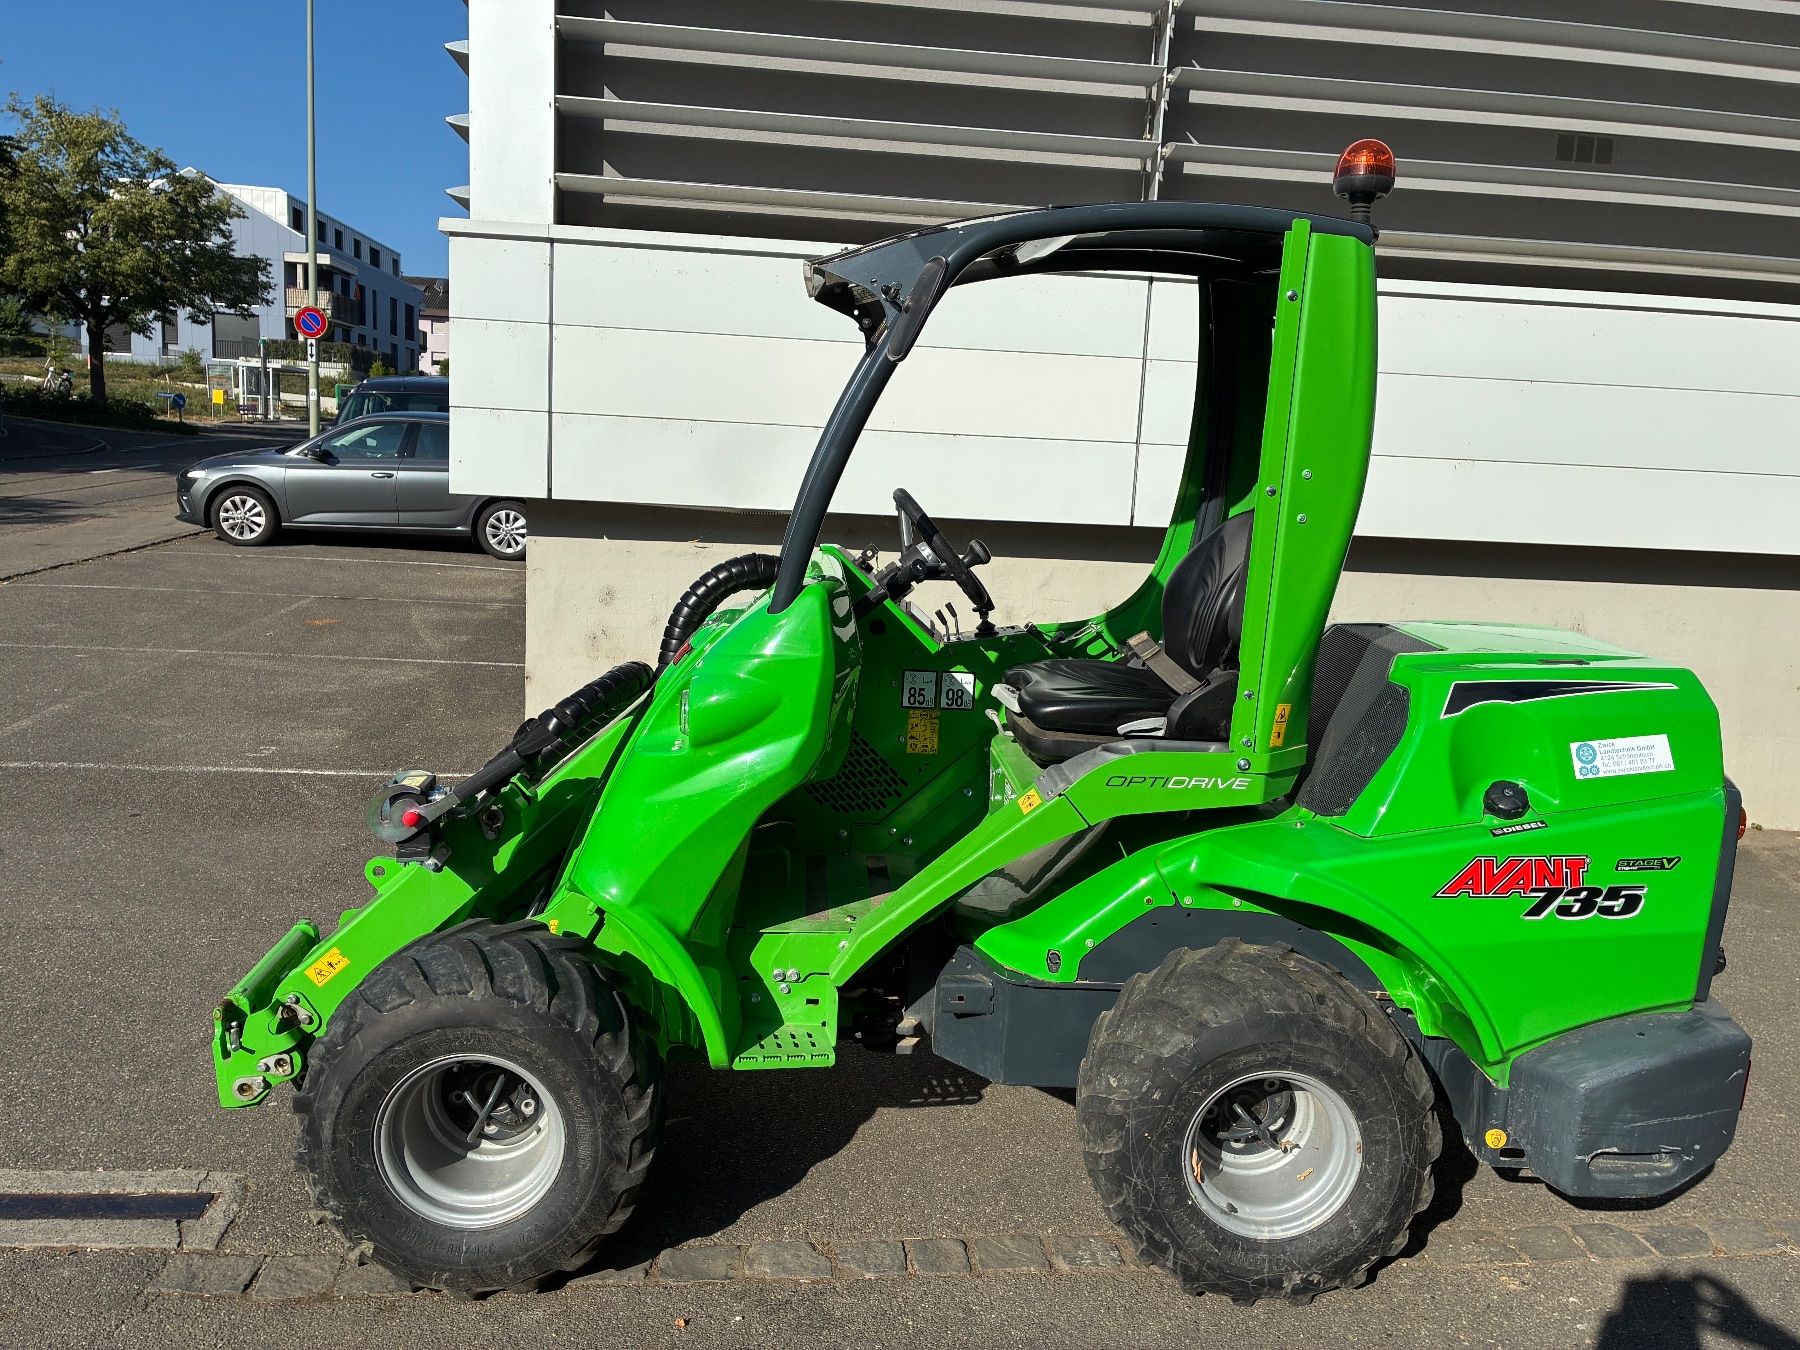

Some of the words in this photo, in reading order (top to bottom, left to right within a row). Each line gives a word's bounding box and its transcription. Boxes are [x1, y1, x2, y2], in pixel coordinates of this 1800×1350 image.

[908, 687, 926, 706] 85
[926, 698, 934, 707] dB
[946, 688, 964, 707] 98
[964, 699, 972, 708] dB
[1599, 746, 1635, 754] Landtechnik
[1105, 775, 1253, 790] OPTIDRIVE
[1502, 821, 1546, 834] DIESEL
[1432, 855, 1590, 898] AVANT
[1521, 885, 1648, 920] 735
